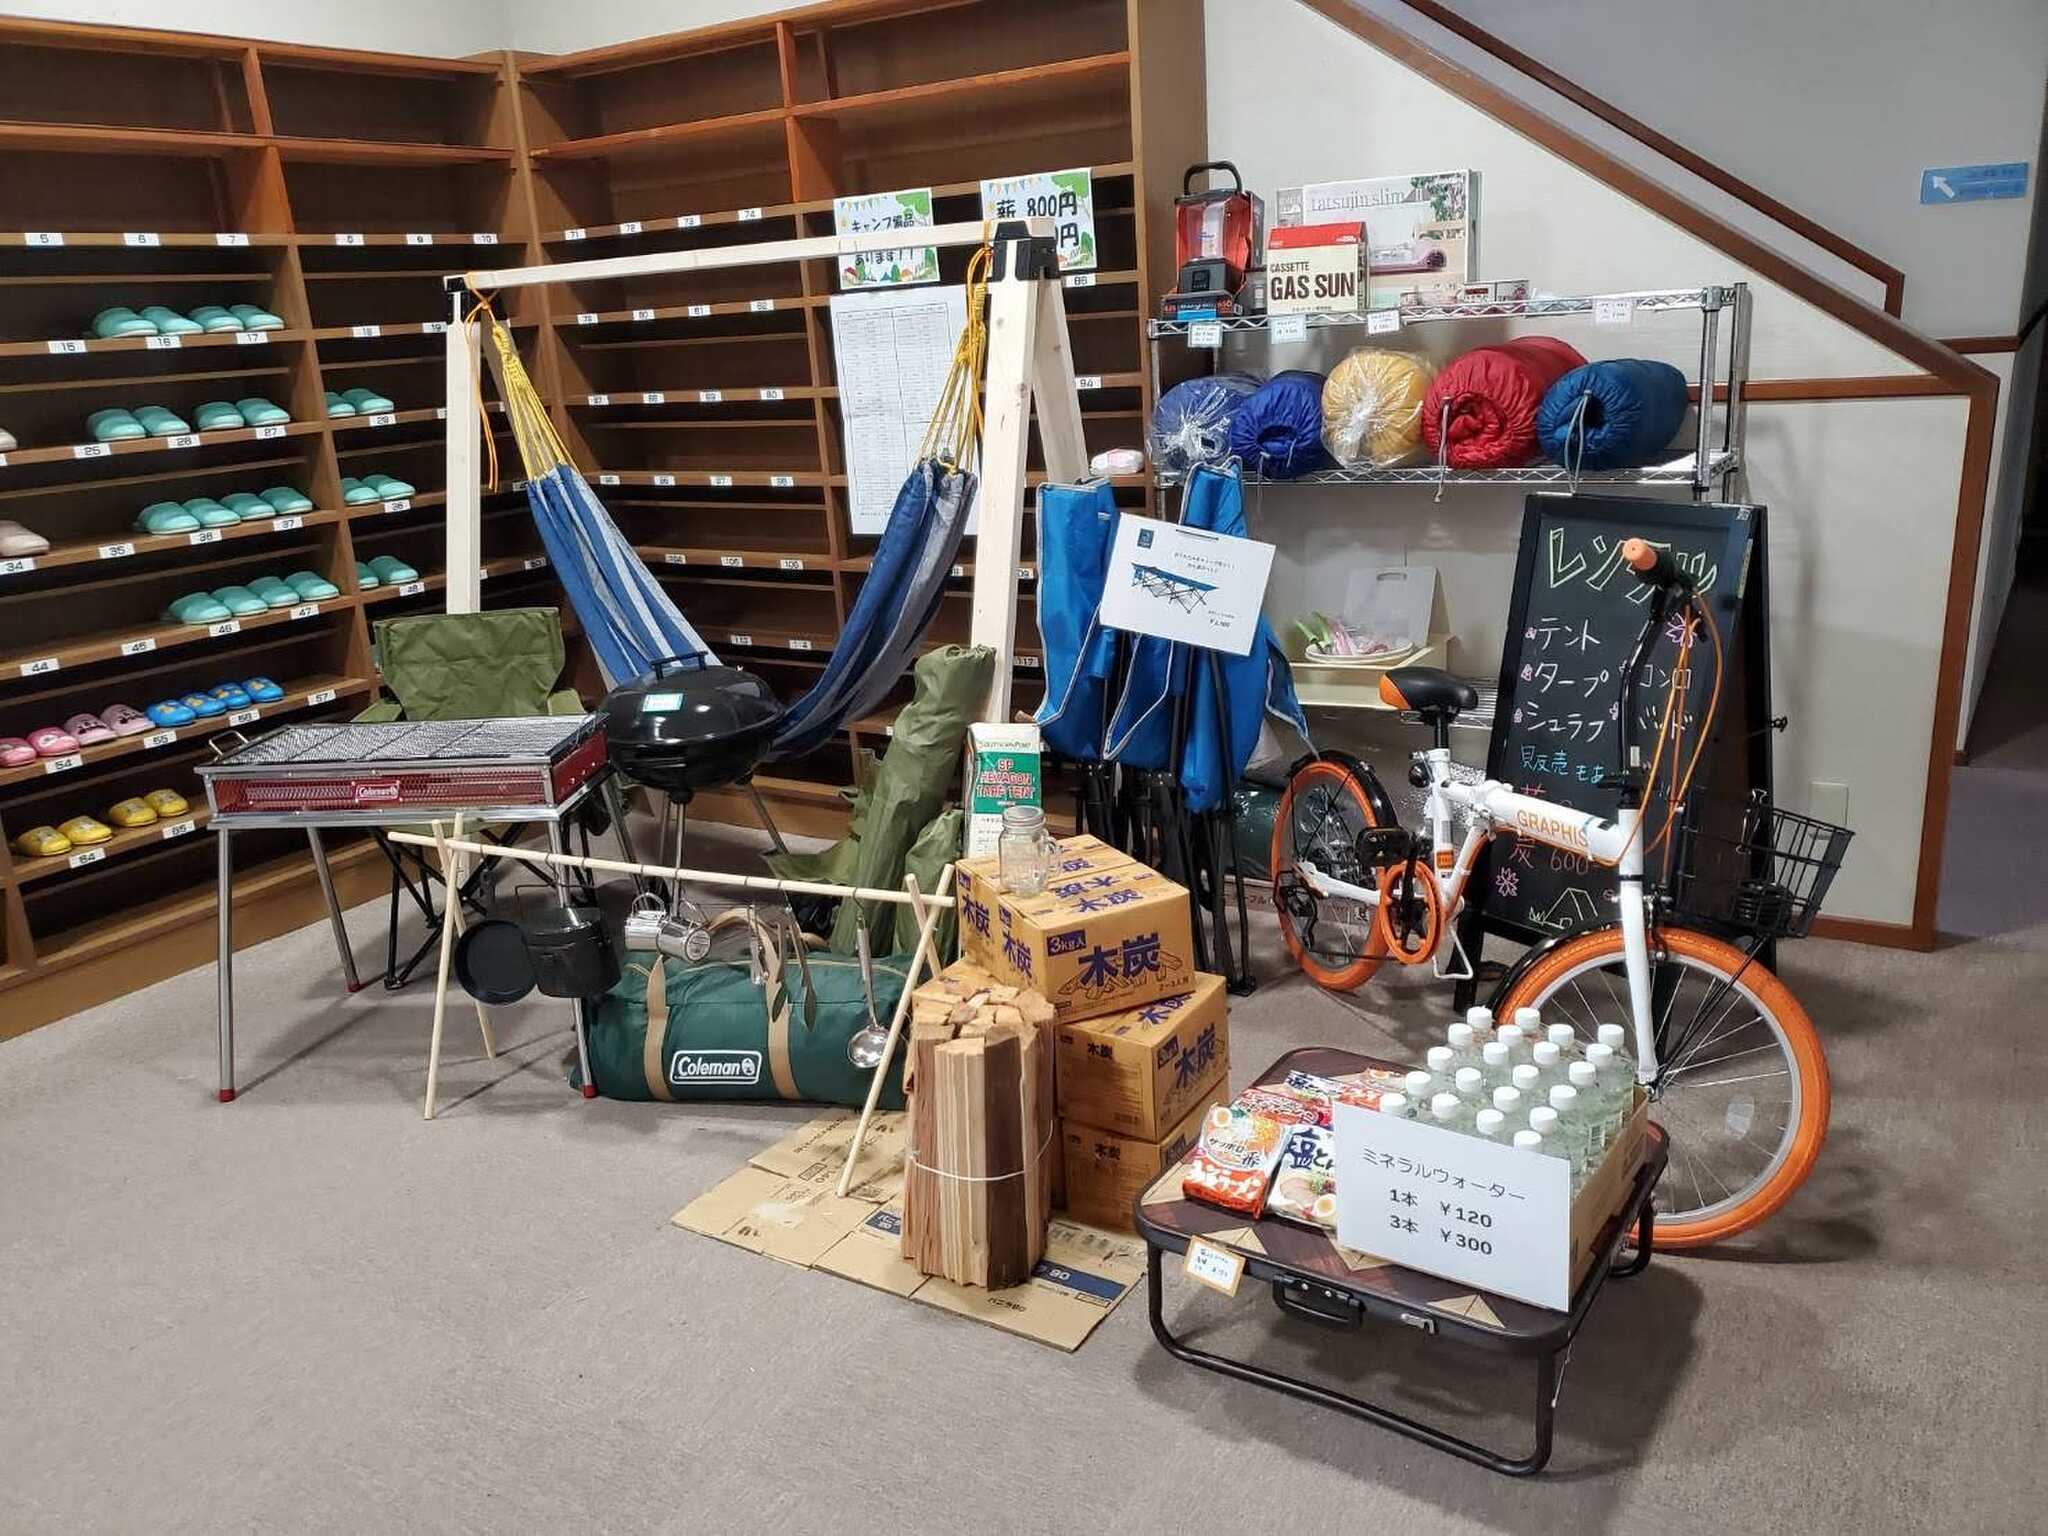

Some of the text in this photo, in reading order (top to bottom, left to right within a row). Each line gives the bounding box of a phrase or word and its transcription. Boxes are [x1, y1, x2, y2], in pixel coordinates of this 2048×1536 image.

[1027, 191, 1078, 218] 800円
[744, 210, 756, 219] 74
[625, 224, 637, 232] 72
[40, 234, 50, 244] 5
[137, 235, 147, 244] 6
[228, 235, 237, 244] 7
[1269, 261, 1310, 273] CASSETTE
[1270, 275, 1310, 301] GAS
[1314, 272, 1355, 298] SUN
[431, 323, 442, 333] 19
[157, 337, 171, 346] 16
[247, 333, 259, 343] 17
[263, 428, 278, 437] 27
[83, 446, 101, 457] 25
[280, 519, 295, 529] 37
[109, 545, 126, 556] 35
[5, 561, 25, 572] 34
[298, 607, 313, 617] 47
[1537, 617, 1601, 652] テント
[131, 641, 148, 652] 45
[30, 661, 51, 673] 44
[1535, 662, 1610, 699] タープ
[315, 692, 329, 703] 57
[1527, 701, 1605, 743] シュラフ
[152, 733, 169, 744] 55
[54, 758, 73, 770] 54
[997, 758, 1014, 772] SP
[1516, 809, 1590, 847] GRAPHIS
[961, 893, 991, 939] 木炭
[1002, 929, 1033, 981] 木炭
[1078, 931, 1162, 987] 木炭
[1174, 1021, 1217, 1090] 木炭
[678, 1055, 740, 1077] Coleman
[1363, 1147, 1526, 1201] ミネラルウォーター
[1389, 1189, 1493, 1229] 1本 ¥120
[1389, 1214, 1493, 1256] 3本 ¥300
